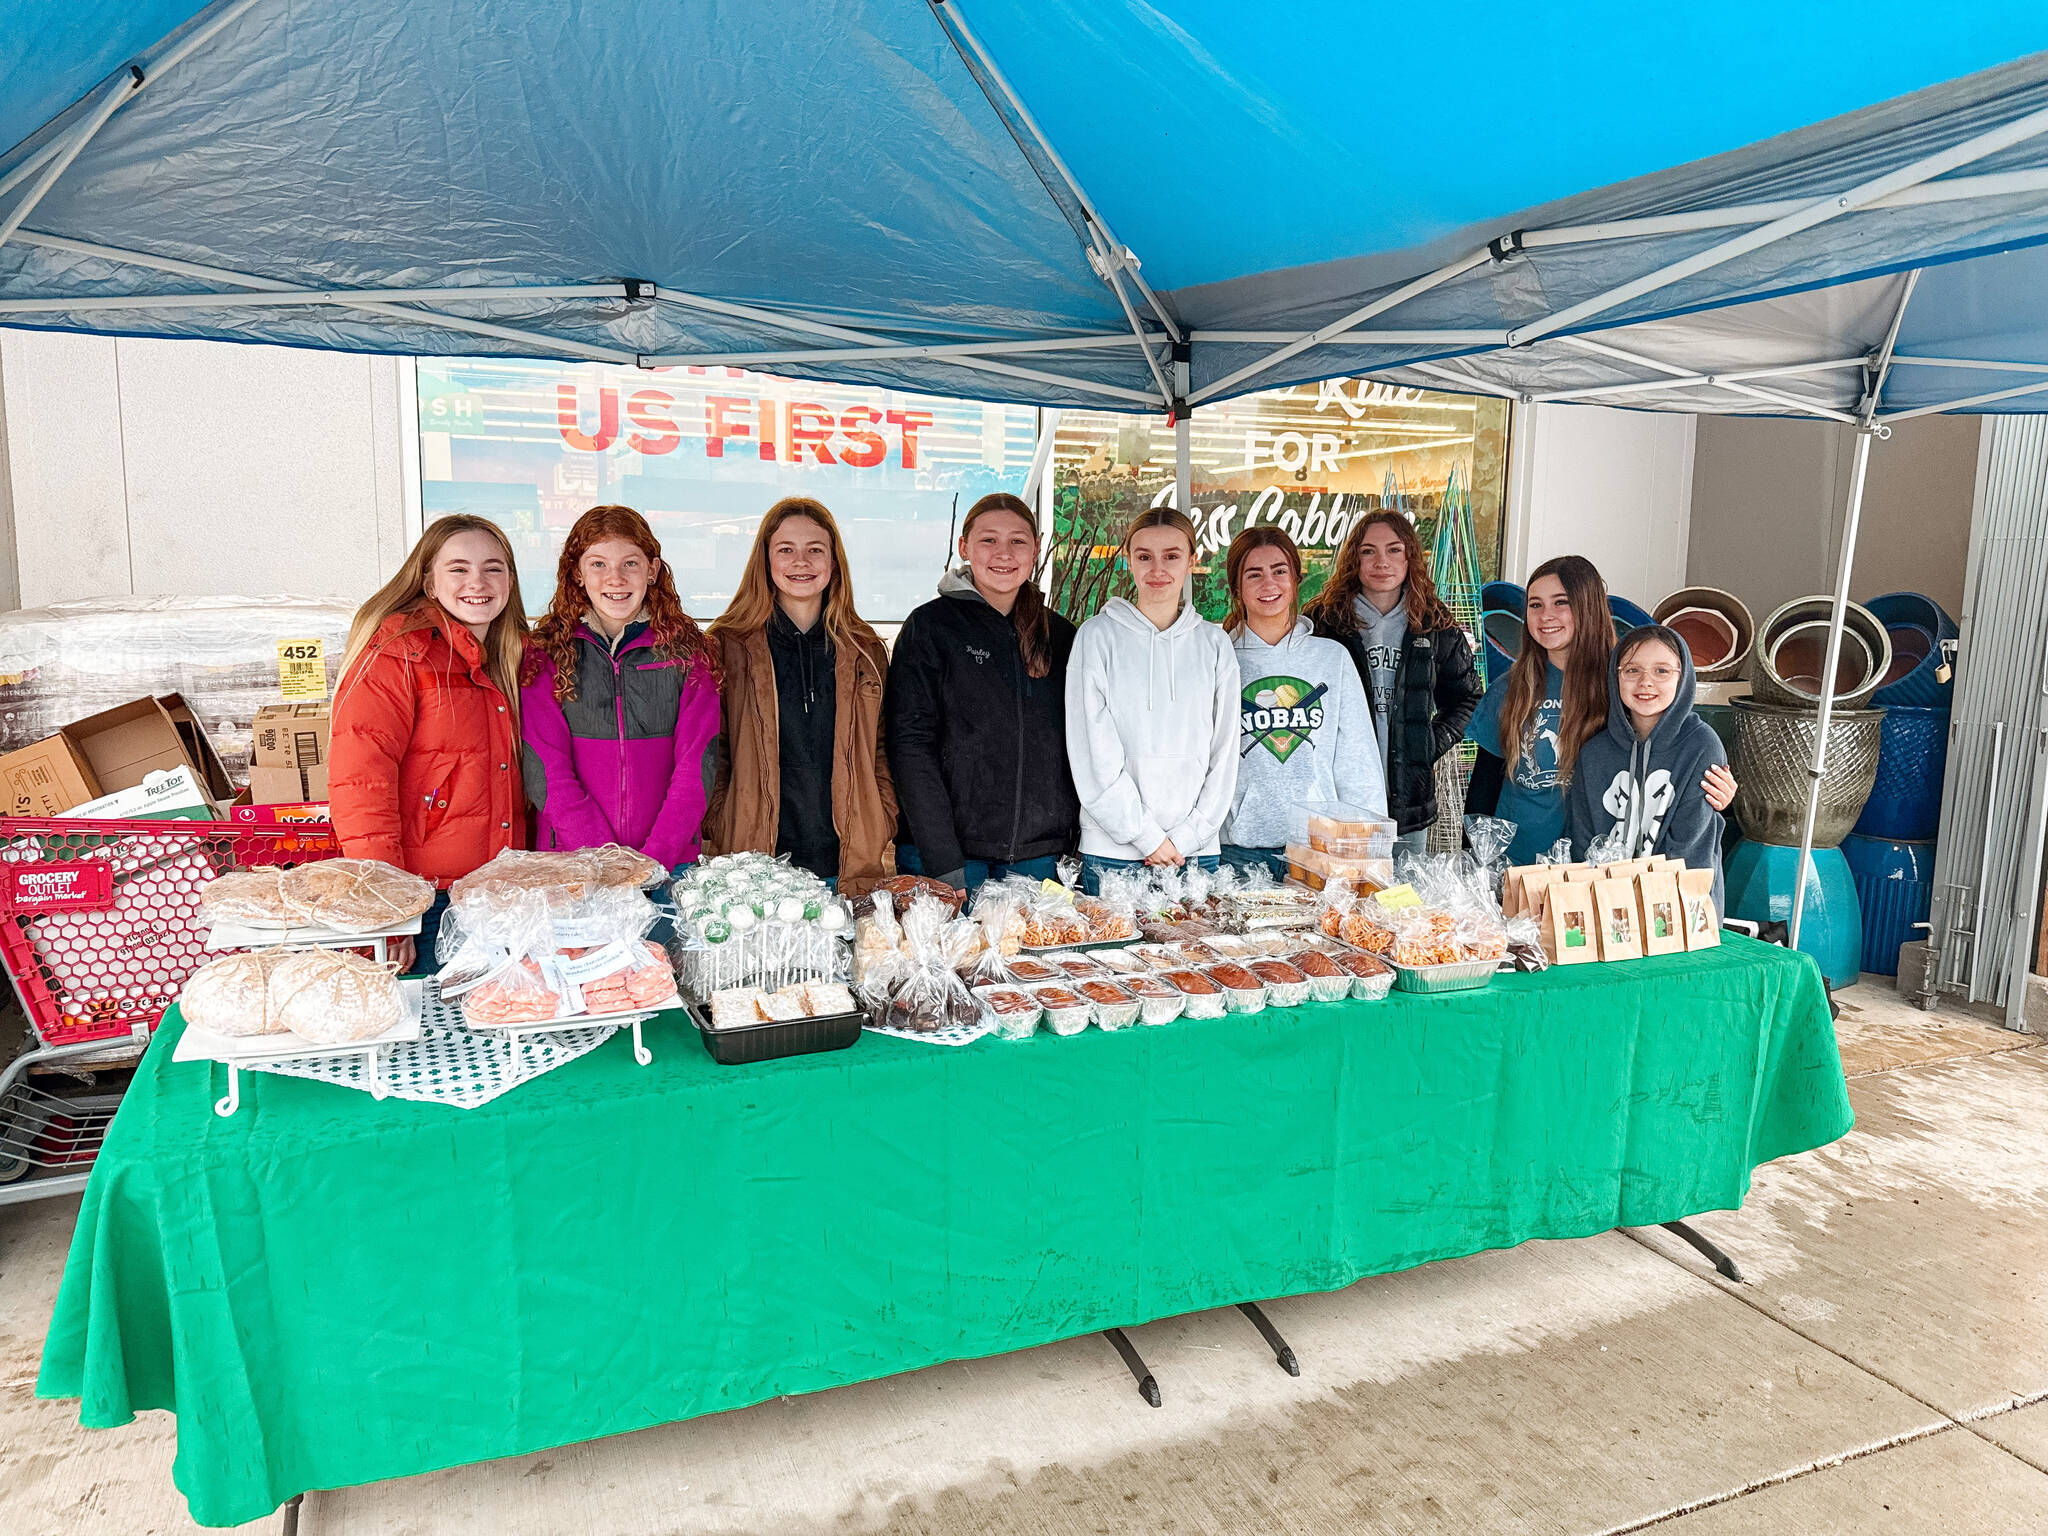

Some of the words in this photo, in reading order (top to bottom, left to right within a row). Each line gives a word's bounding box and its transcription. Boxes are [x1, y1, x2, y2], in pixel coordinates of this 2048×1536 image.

[556, 383, 682, 456] US
[705, 394, 934, 470] FIRST
[1244, 429, 1340, 473] FOR
[283, 645, 318, 659] 452
[165, 774, 184, 790] TOP
[18, 870, 80, 886] GROCERY
[28, 882, 71, 896] OUTLET
[15, 892, 53, 906] bargain
[54, 891, 87, 901] market
